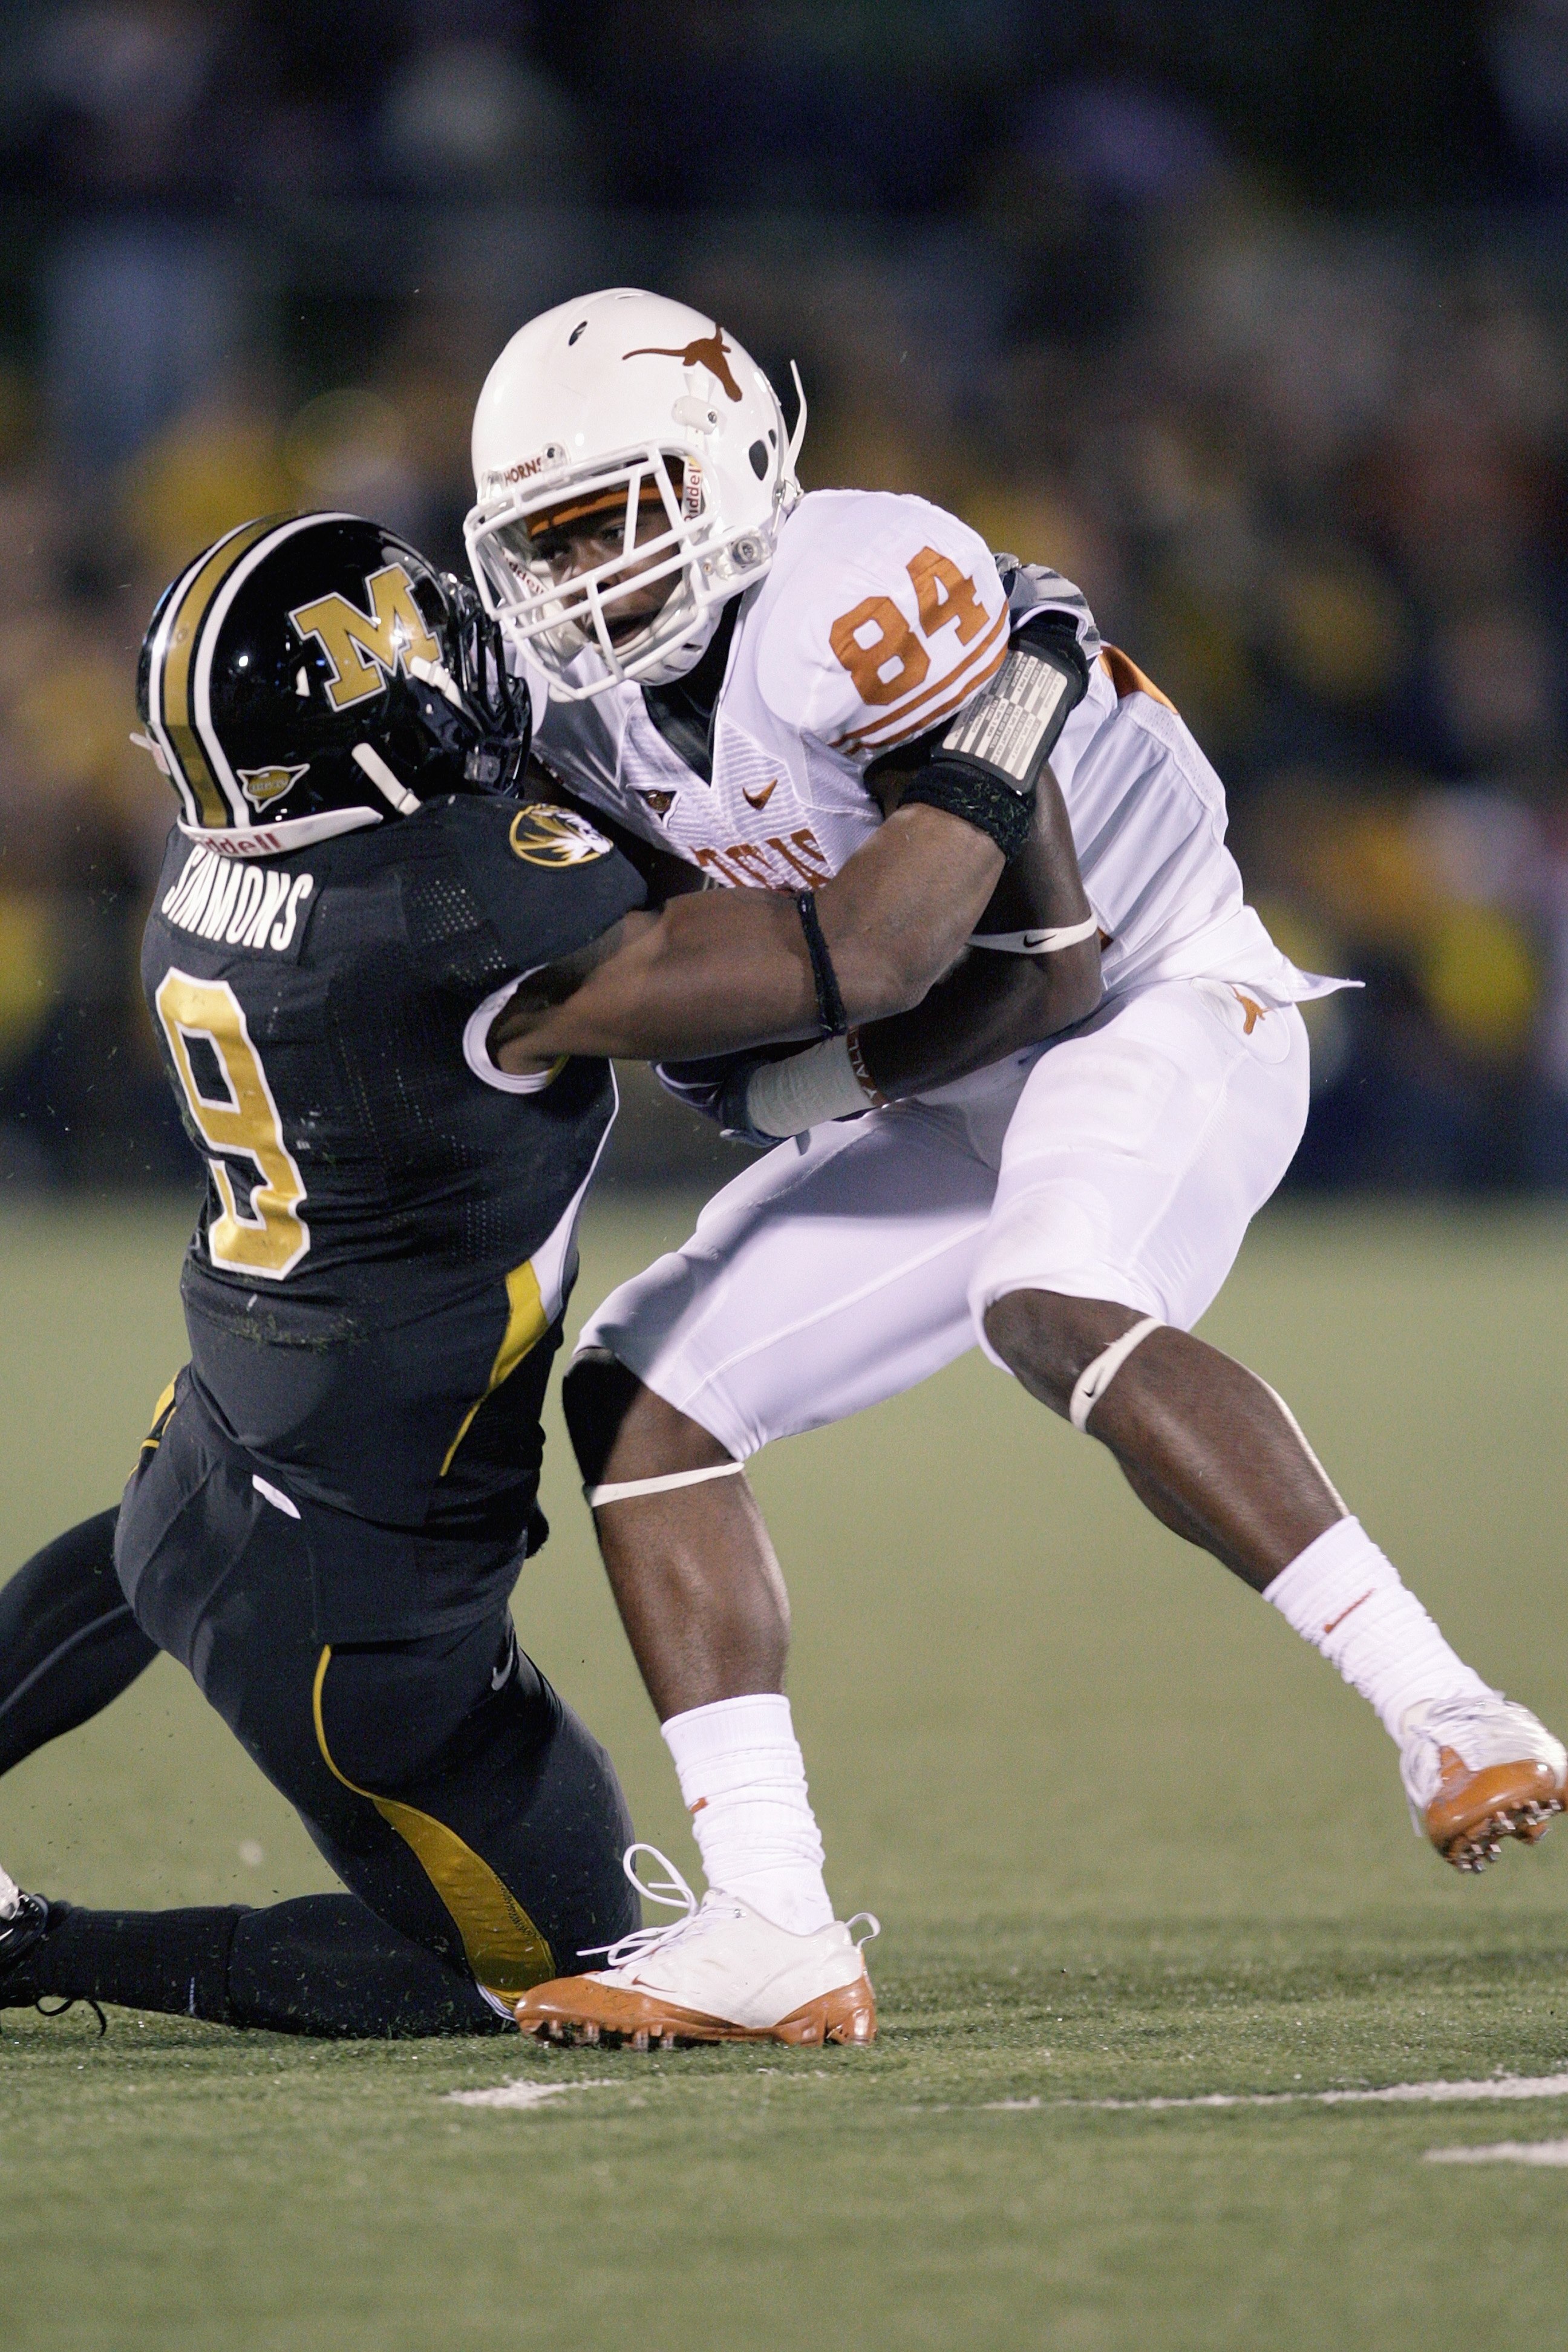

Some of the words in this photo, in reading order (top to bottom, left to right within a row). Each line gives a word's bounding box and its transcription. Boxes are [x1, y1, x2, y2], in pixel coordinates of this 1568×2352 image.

[290, 562, 440, 712] M
[829, 545, 990, 705] 84
[162, 844, 314, 952] SIMMONS
[155, 967, 311, 1281] 9
